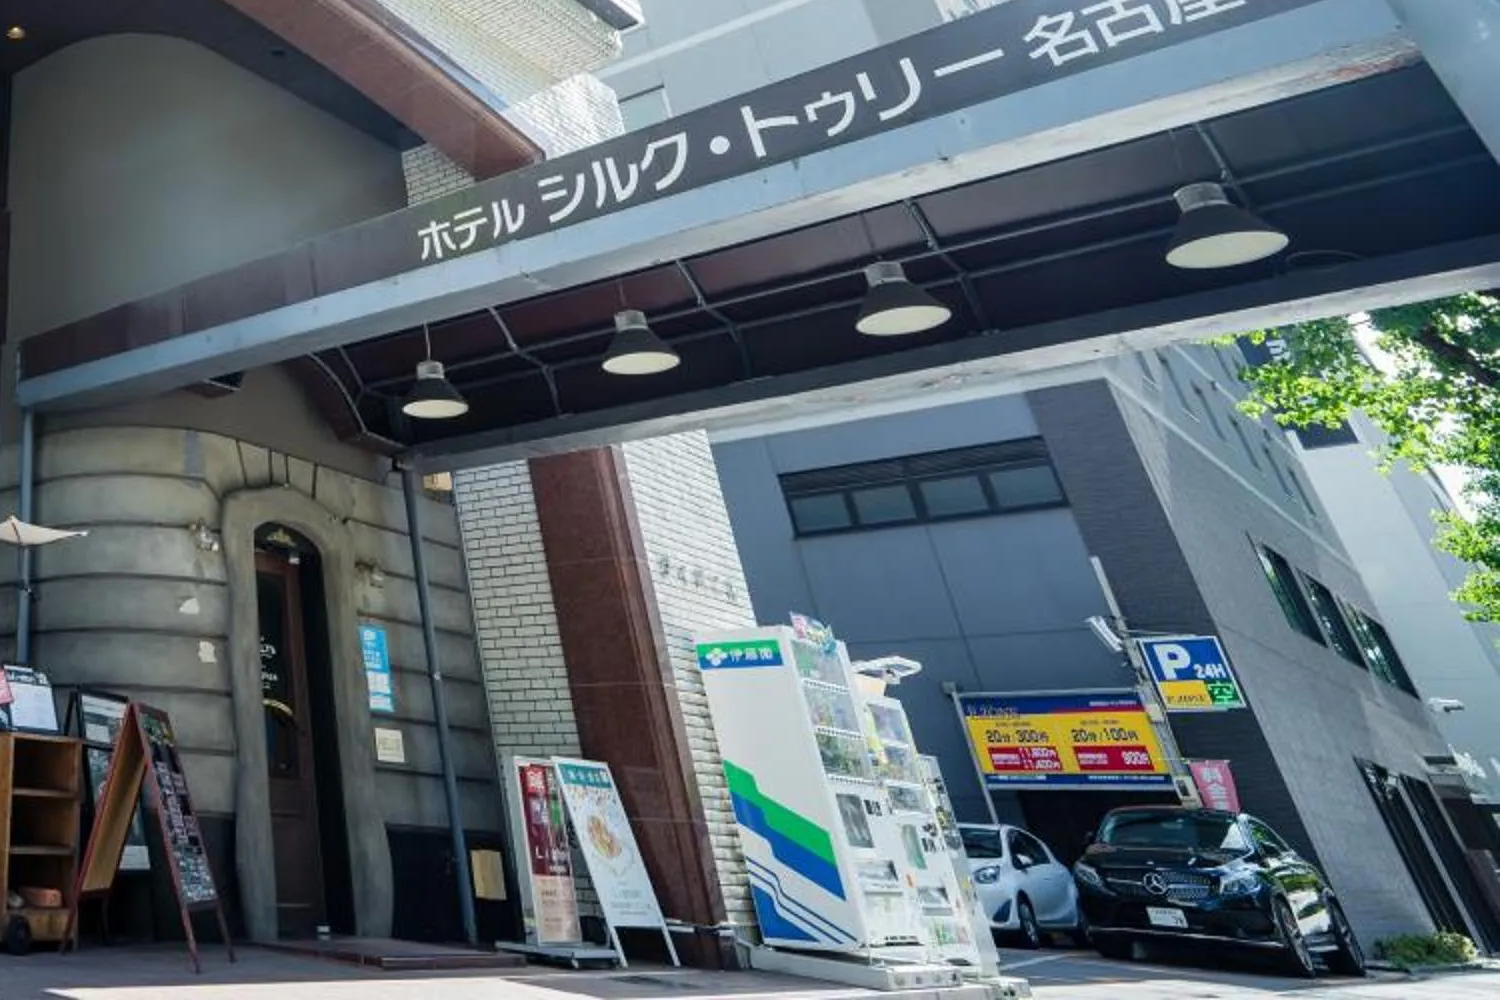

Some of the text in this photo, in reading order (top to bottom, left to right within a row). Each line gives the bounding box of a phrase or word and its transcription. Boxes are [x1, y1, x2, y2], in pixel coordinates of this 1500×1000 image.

[417, 197, 526, 262] ホテル
[537, 48, 1005, 223] シルク・トゥリー
[1153, 644, 1227, 679] P 24H
